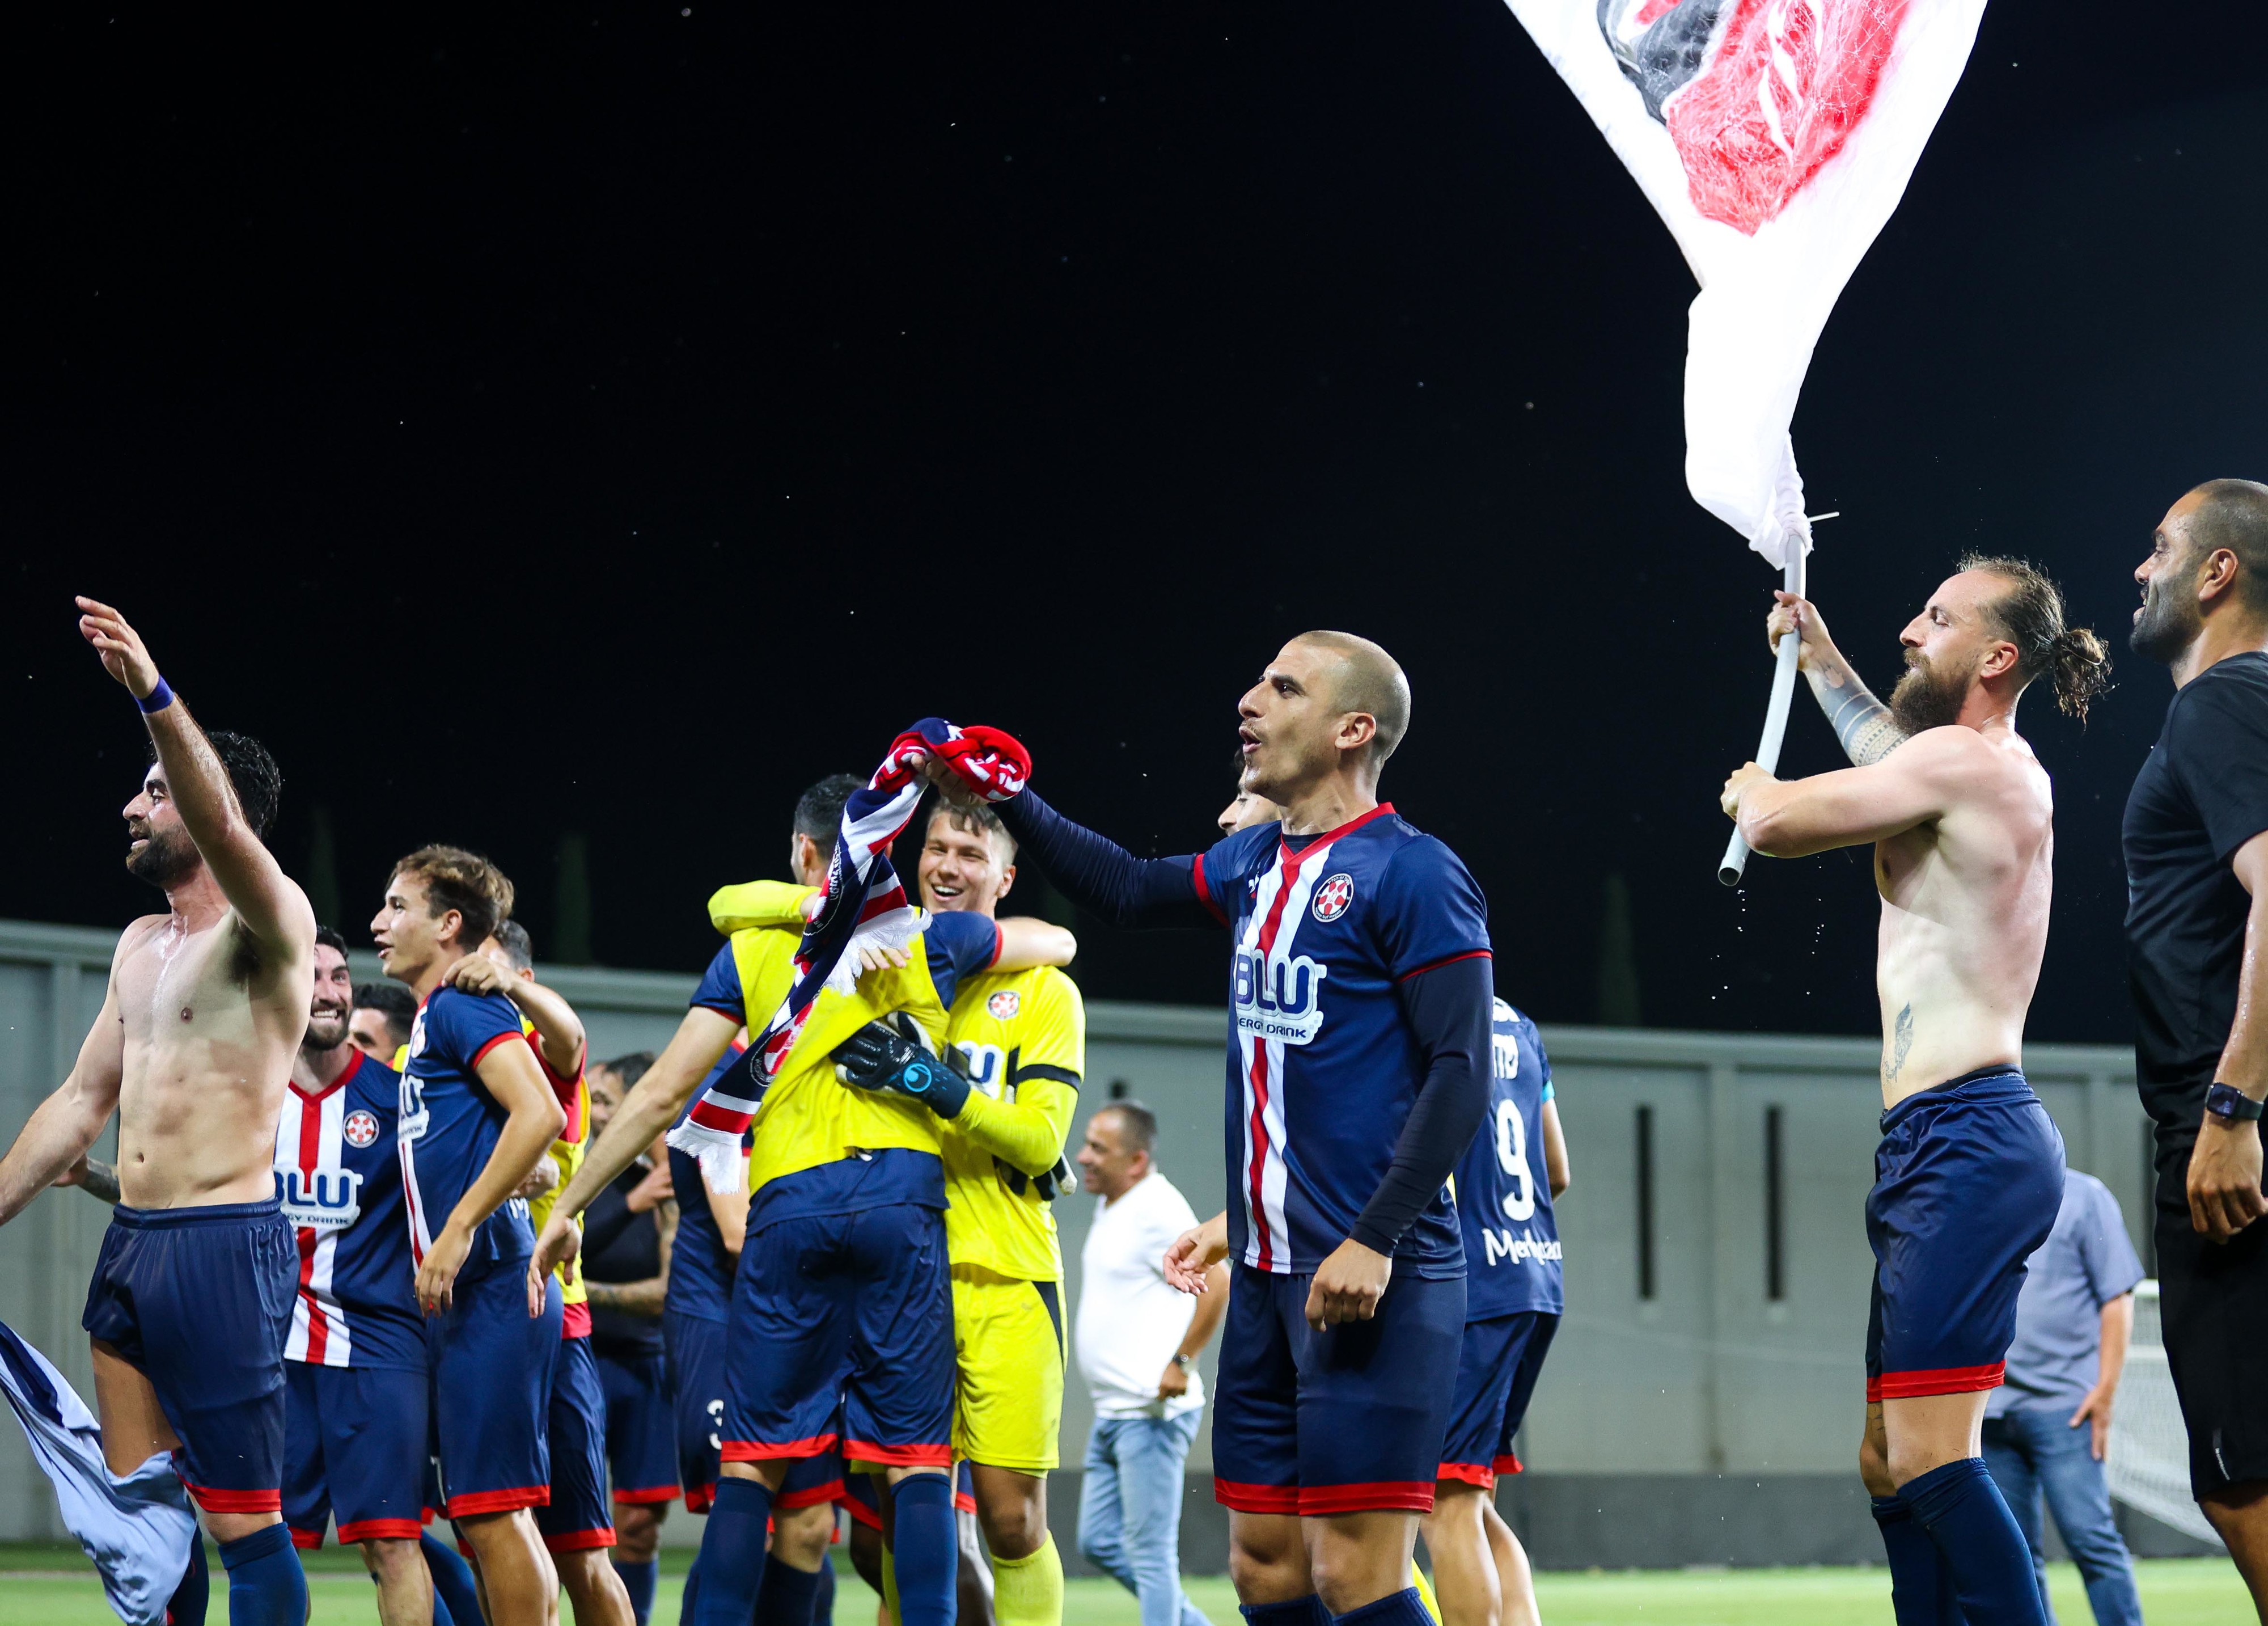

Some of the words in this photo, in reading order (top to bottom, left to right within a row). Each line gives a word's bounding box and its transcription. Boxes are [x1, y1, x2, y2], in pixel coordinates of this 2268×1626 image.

[1235, 953, 1310, 1014] BLU
[1266, 1024, 1306, 1038] DRINK
[1495, 1098, 1534, 1221] 9
